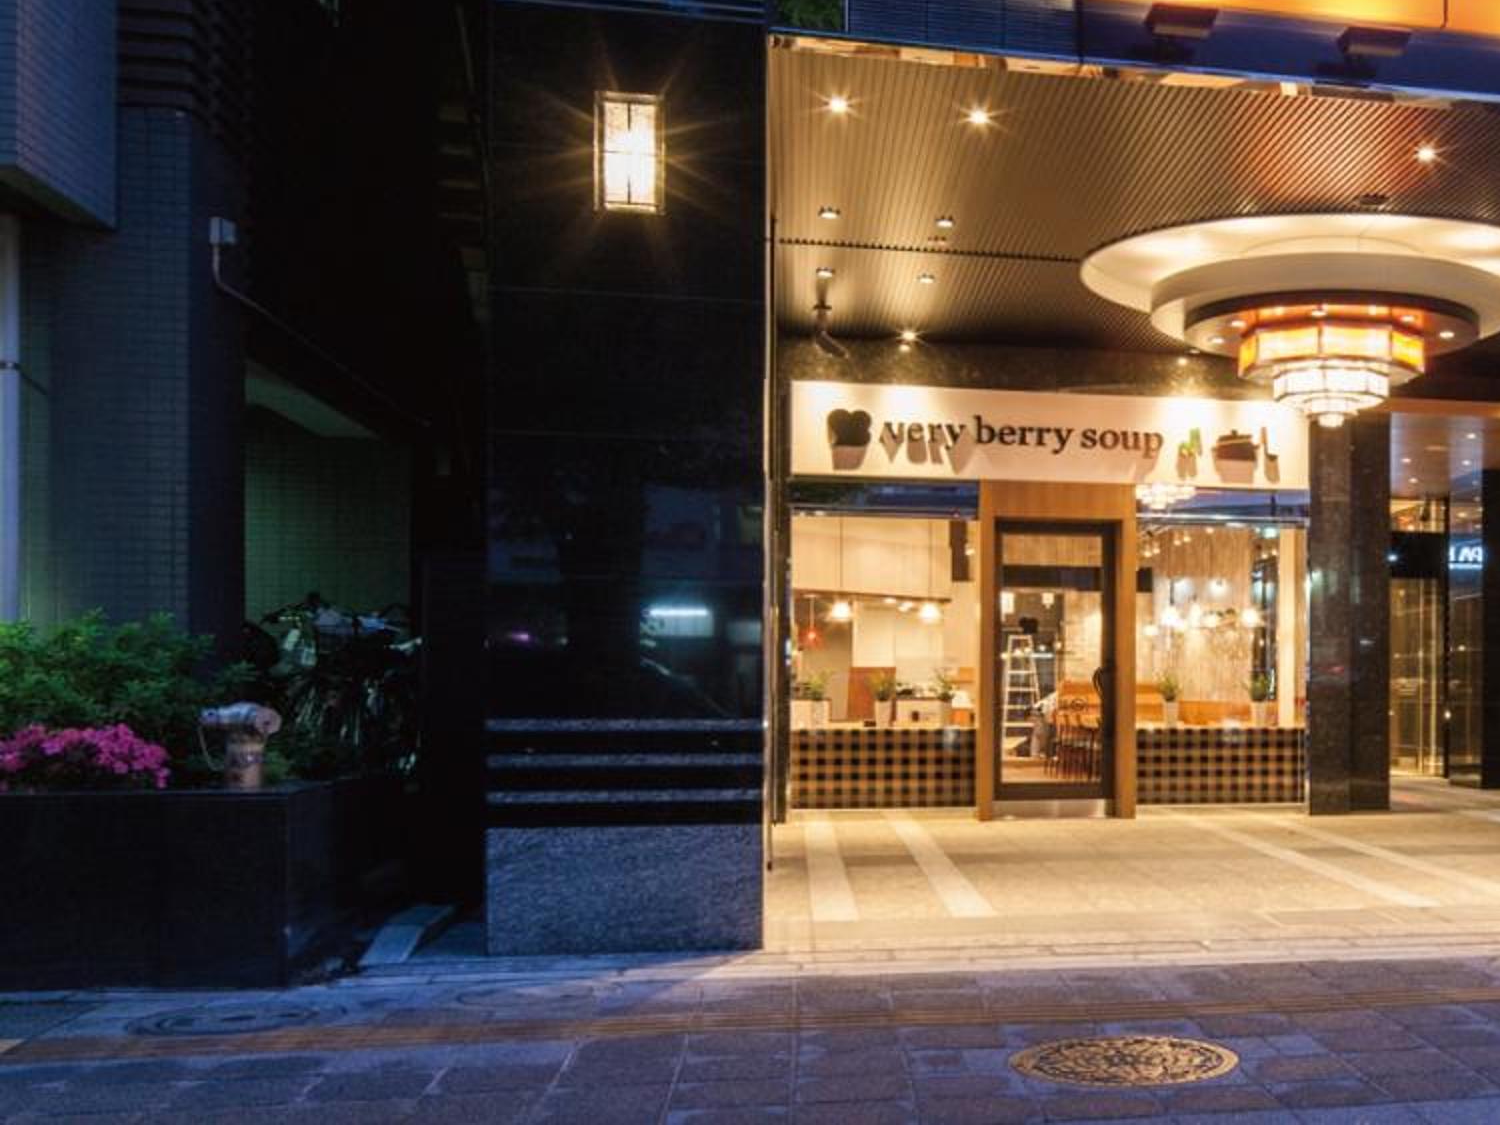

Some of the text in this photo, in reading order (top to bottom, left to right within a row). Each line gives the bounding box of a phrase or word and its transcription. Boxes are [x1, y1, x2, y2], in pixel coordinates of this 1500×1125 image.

[883, 415, 1164, 459] very berry soup
